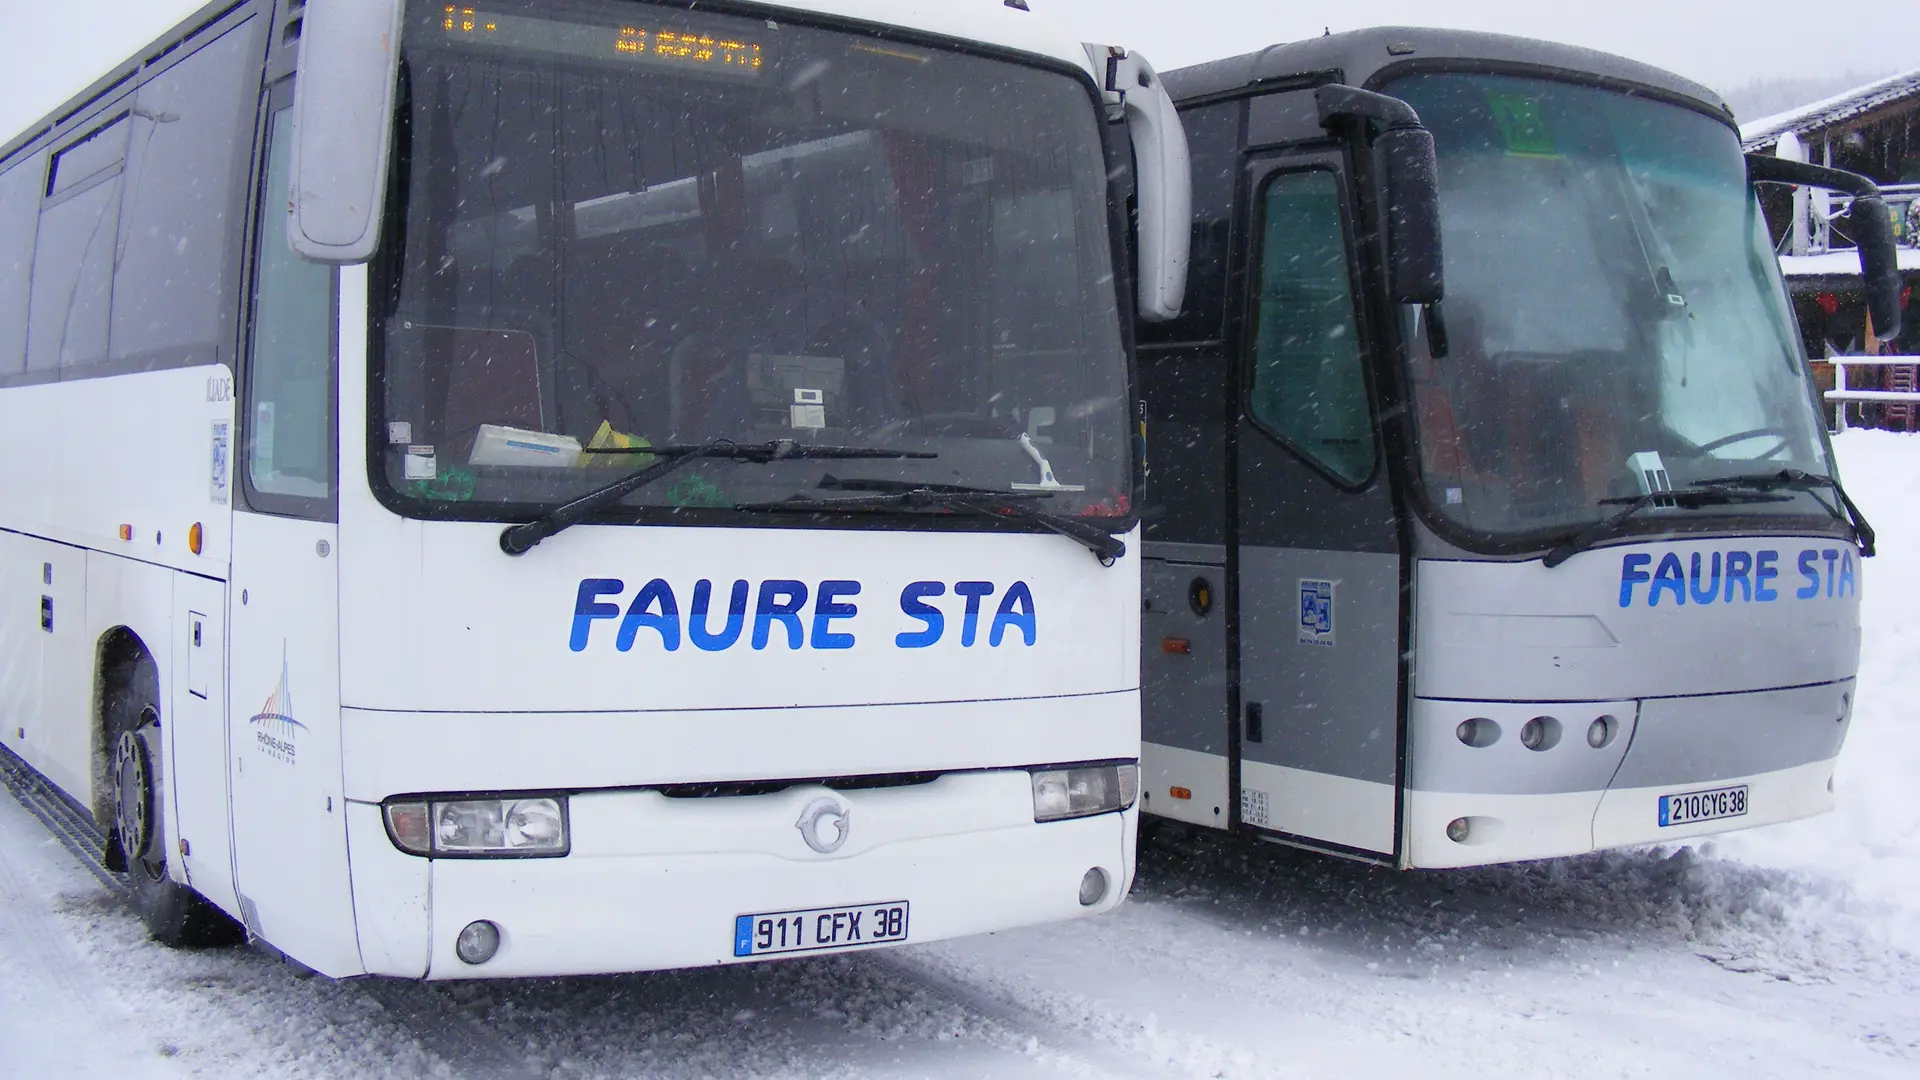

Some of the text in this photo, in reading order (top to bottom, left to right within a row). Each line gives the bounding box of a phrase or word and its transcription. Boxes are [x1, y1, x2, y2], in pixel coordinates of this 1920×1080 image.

[1619, 549, 1855, 608] FAURE STA
[569, 577, 1037, 652] FAURE STA
[757, 907, 903, 949] 911 CFX 38
